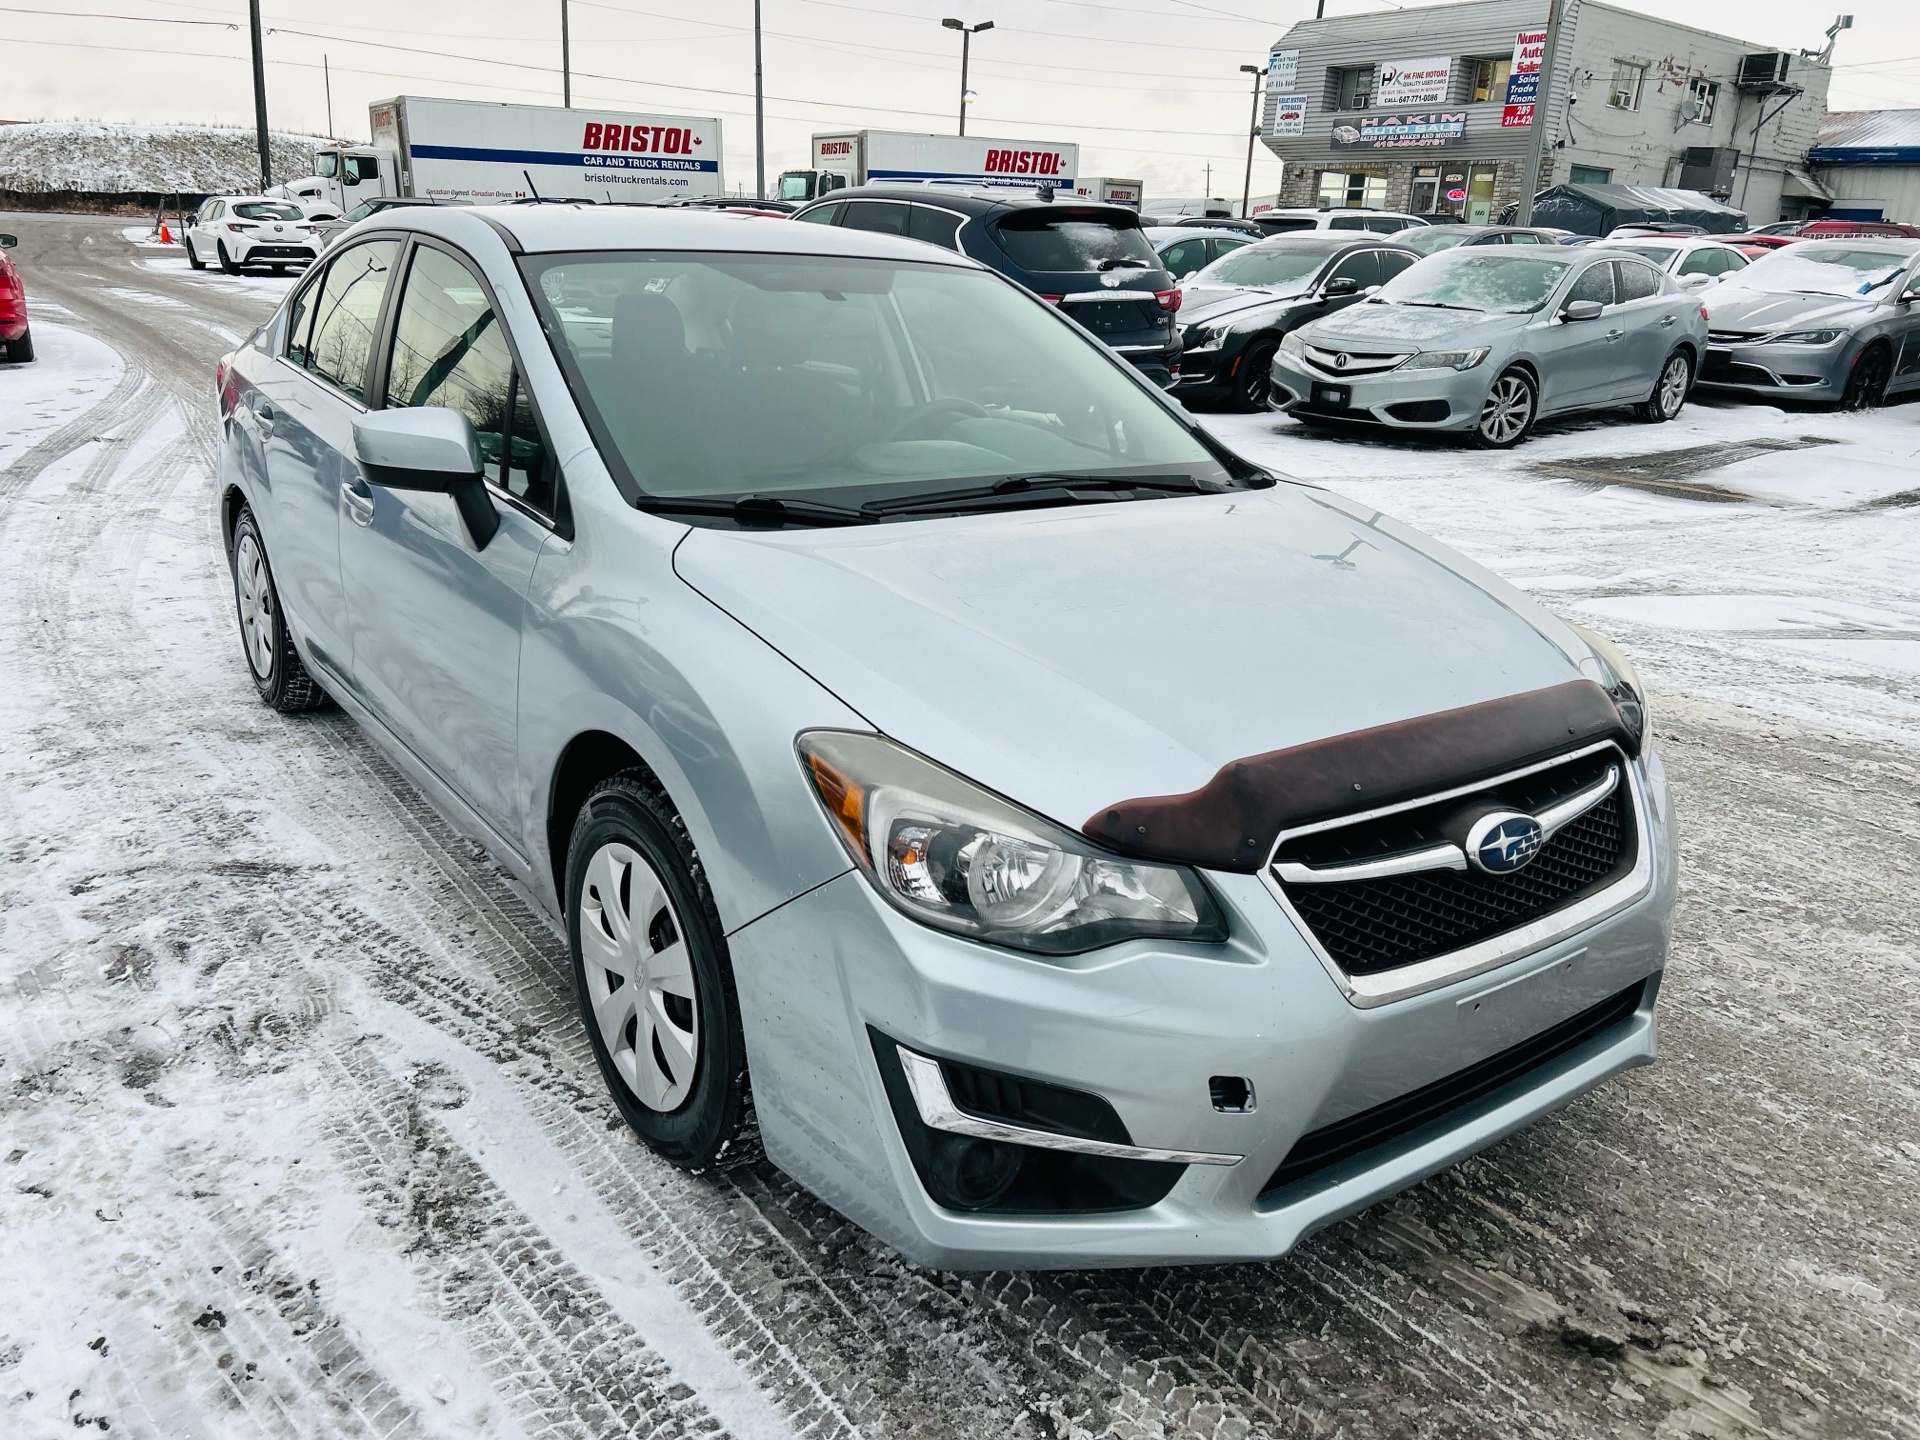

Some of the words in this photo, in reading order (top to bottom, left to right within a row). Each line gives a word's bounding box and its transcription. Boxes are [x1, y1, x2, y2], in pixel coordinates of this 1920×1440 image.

[1403, 72, 1412, 80] HK
[1412, 71, 1425, 79] FINE
[1425, 69, 1448, 79] MOTORS
[1518, 75, 1540, 84] Sales
[1510, 84, 1534, 93] Trade
[1509, 95, 1537, 103] Financ
[1516, 105, 1531, 115] 289
[1361, 113, 1466, 127] HAKIM
[1362, 125, 1408, 136] AUTO
[1415, 123, 1462, 133] SALE
[583, 122, 693, 154] BRISTOL
[821, 141, 850, 155] BRISTOL
[583, 156, 603, 166] CAR
[606, 158, 625, 167] AND
[628, 159, 660, 169] TRUCK
[661, 160, 701, 171] RENTALS
[984, 149, 1060, 175] BRISTOL
[584, 173, 689, 186] bristoltruckrentals.com
[1110, 190, 1132, 199] BRISTOL
